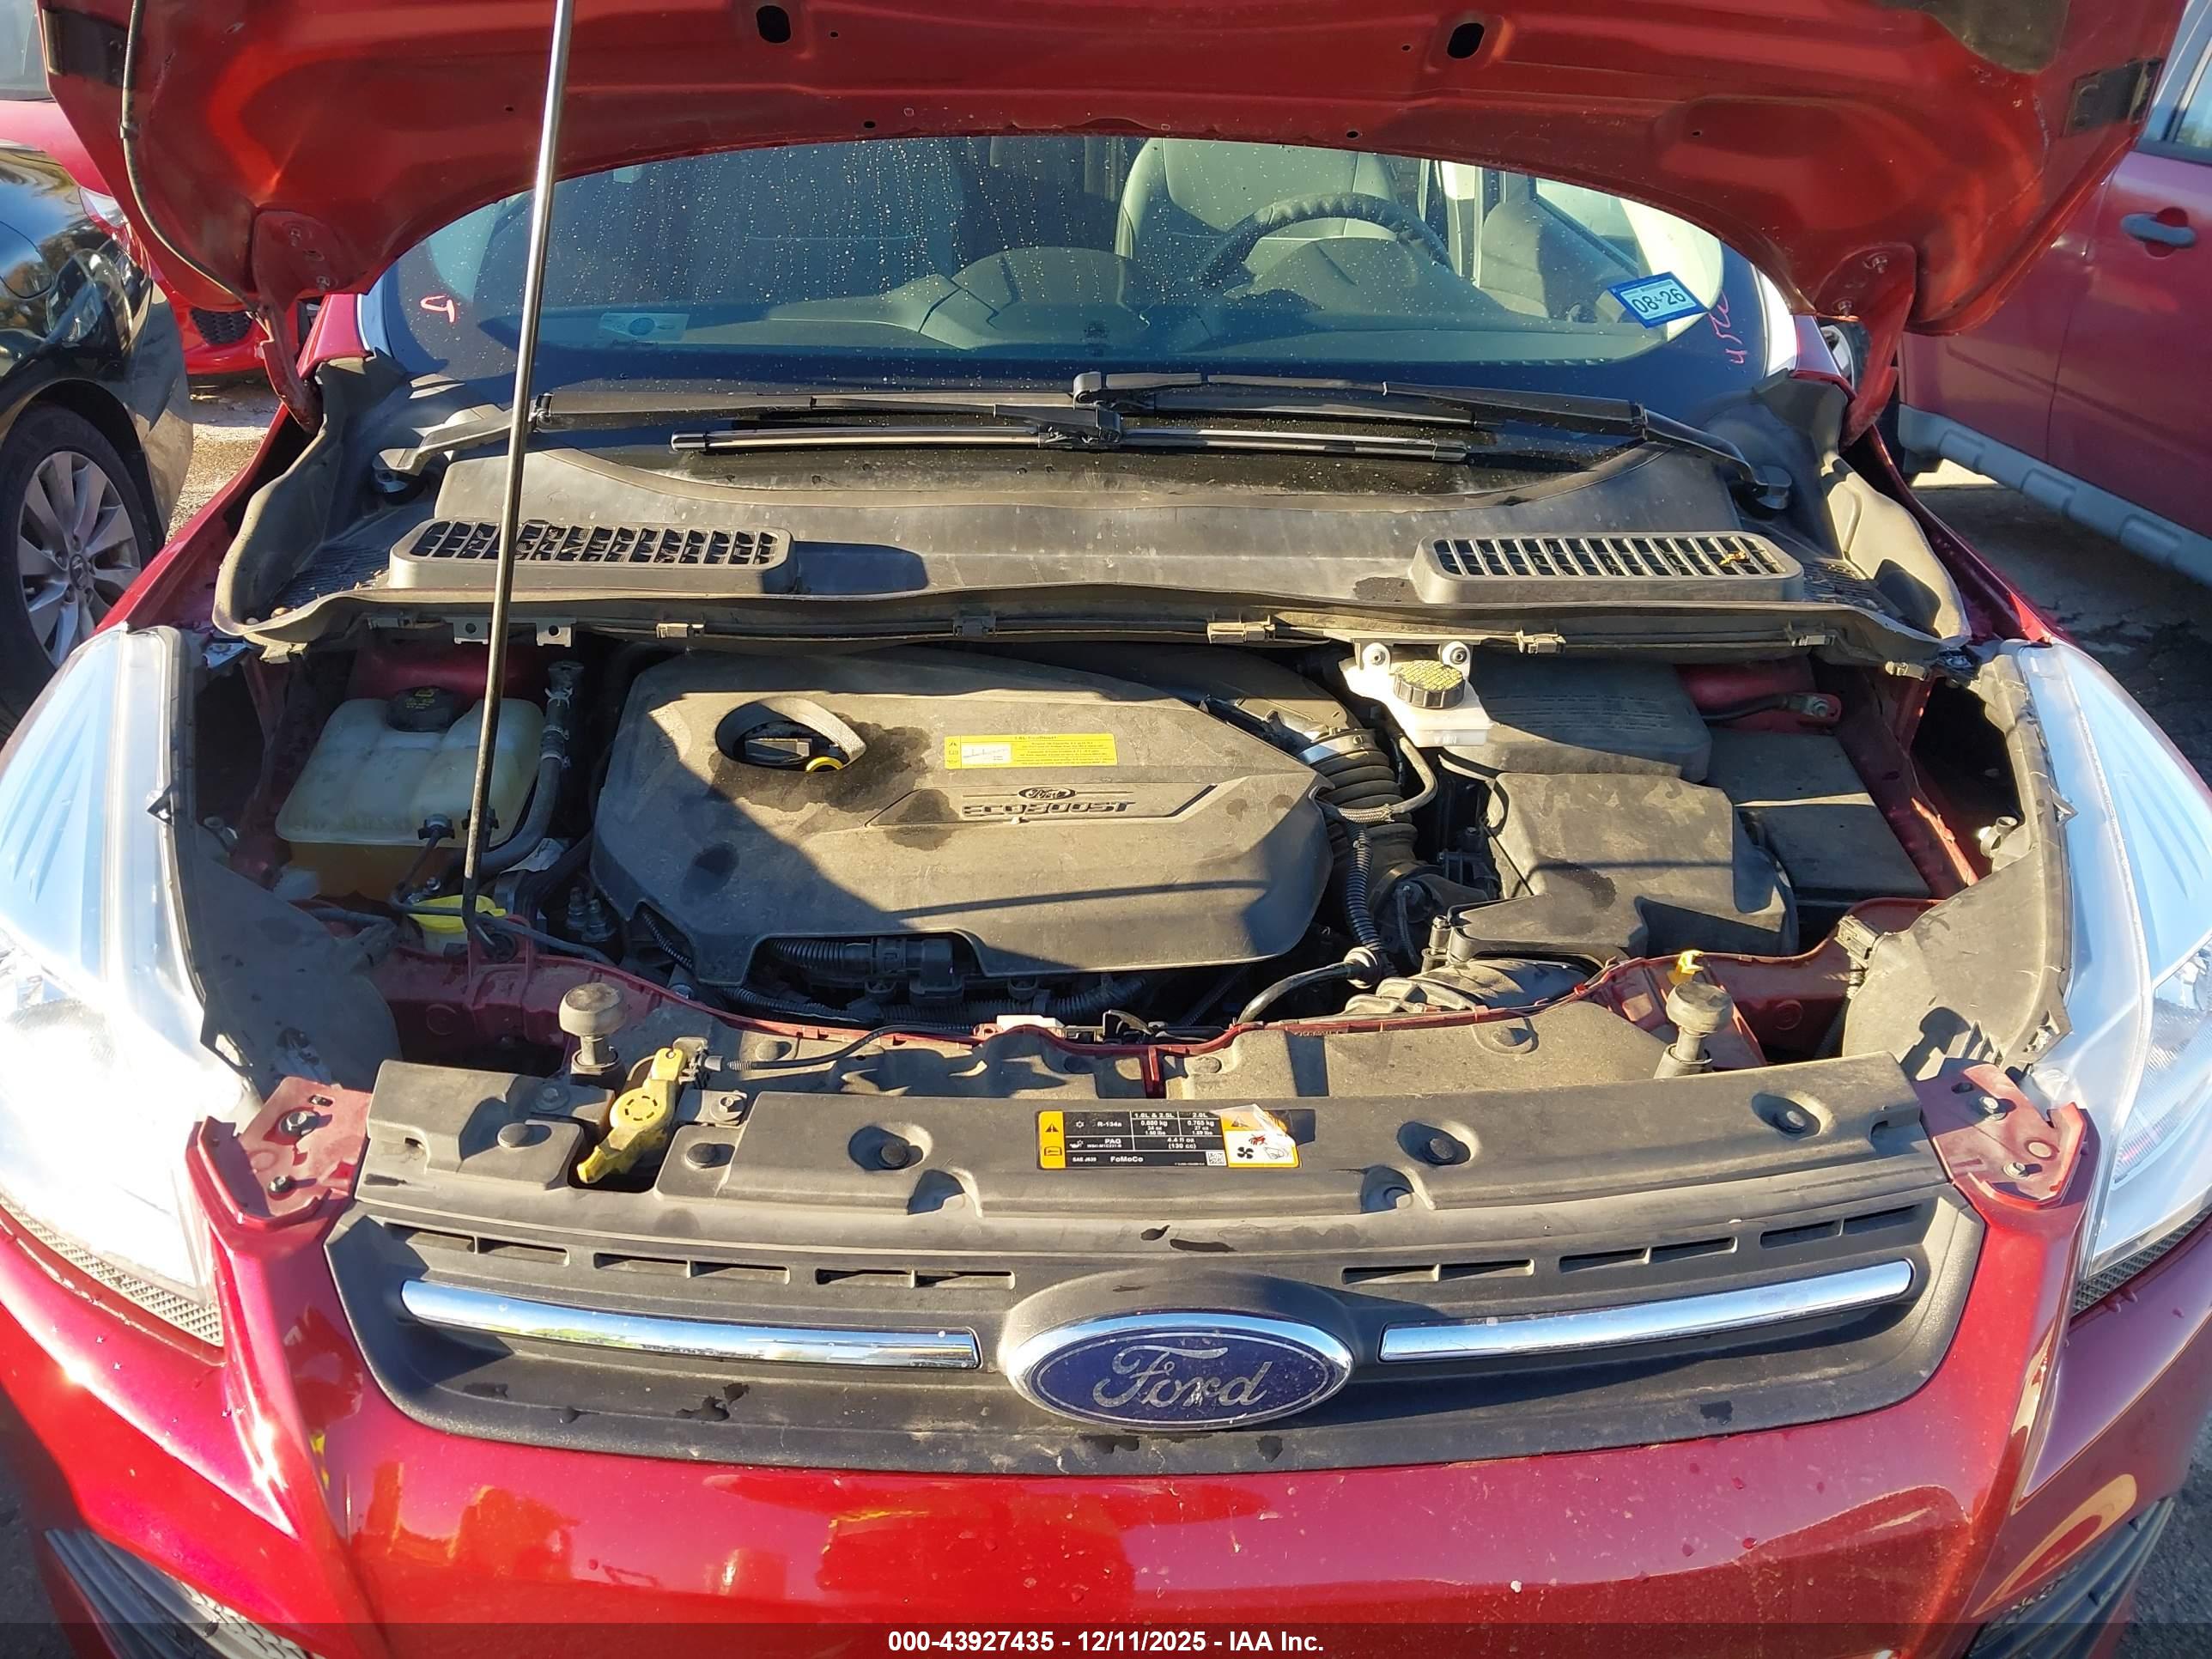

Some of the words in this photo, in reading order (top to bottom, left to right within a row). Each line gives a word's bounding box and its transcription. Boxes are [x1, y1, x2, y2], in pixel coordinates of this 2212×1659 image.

[1632, 295, 1660, 313] 08
[1659, 288, 1687, 306] 26
[1092, 1345, 1273, 1408] Ford
